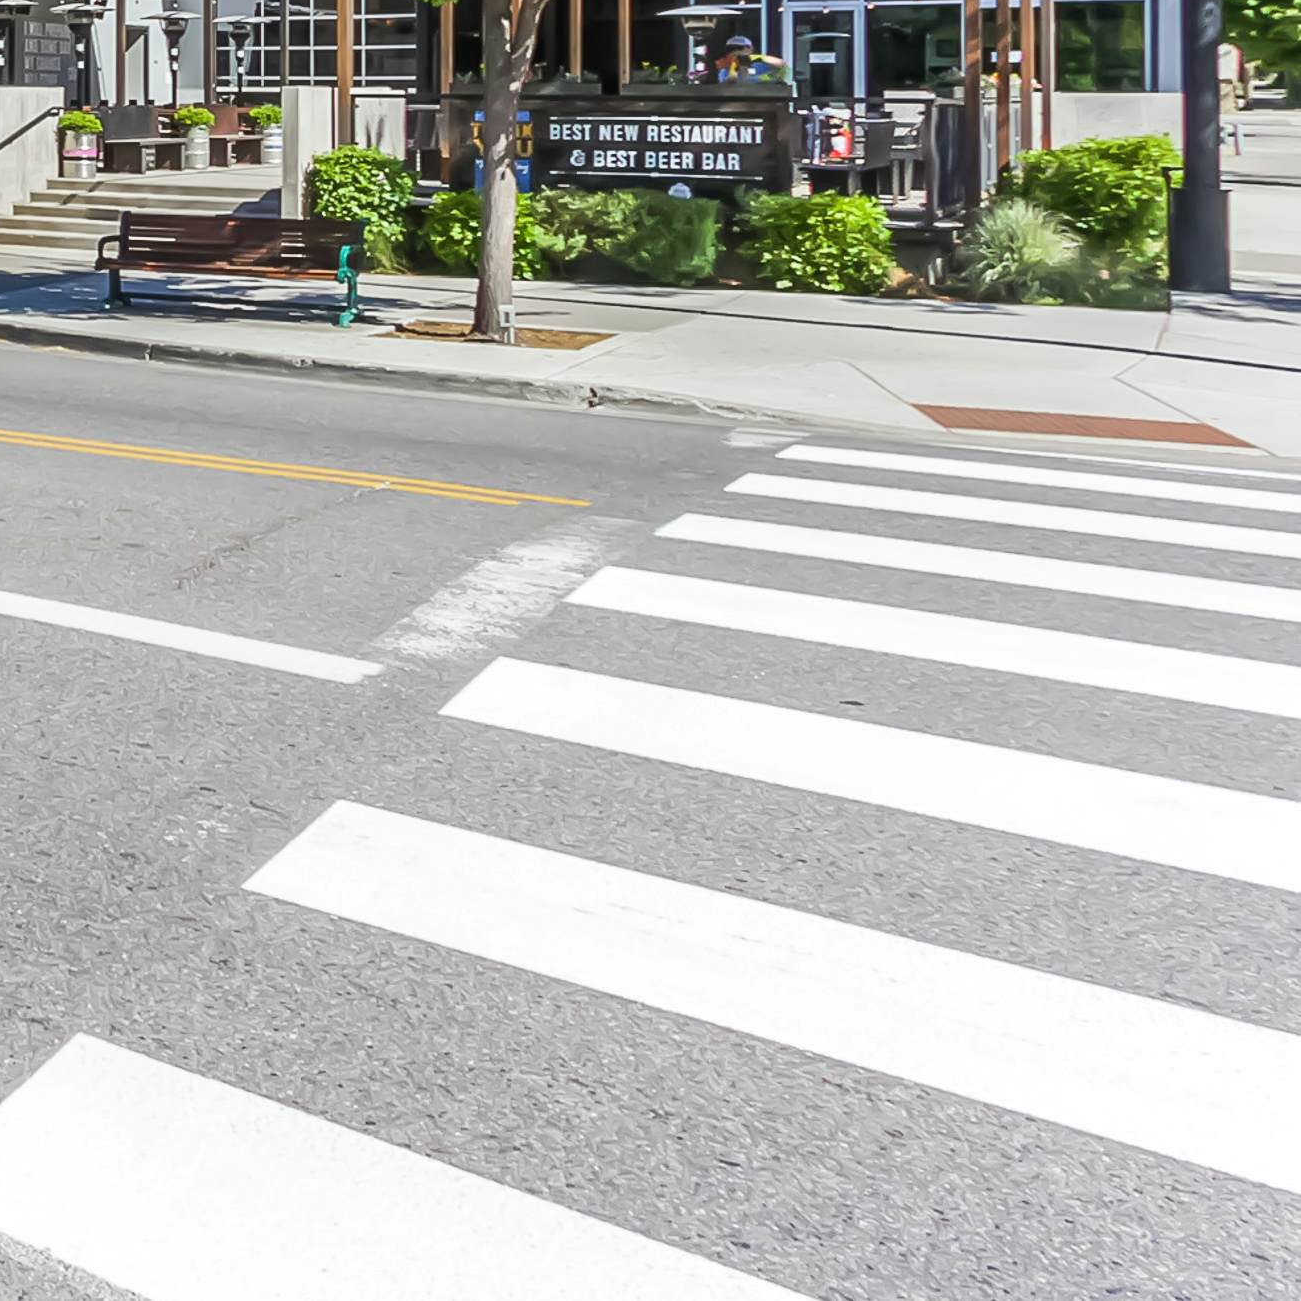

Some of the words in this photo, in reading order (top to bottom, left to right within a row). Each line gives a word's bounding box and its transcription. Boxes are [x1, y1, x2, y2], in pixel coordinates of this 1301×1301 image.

[549, 124, 591, 141] BEST
[599, 124, 639, 142] NEW
[647, 124, 763, 145] RESTAURANT
[570, 150, 586, 167] &
[593, 150, 636, 169] BEST
[645, 151, 695, 170] BEER
[702, 153, 741, 172] BAR
